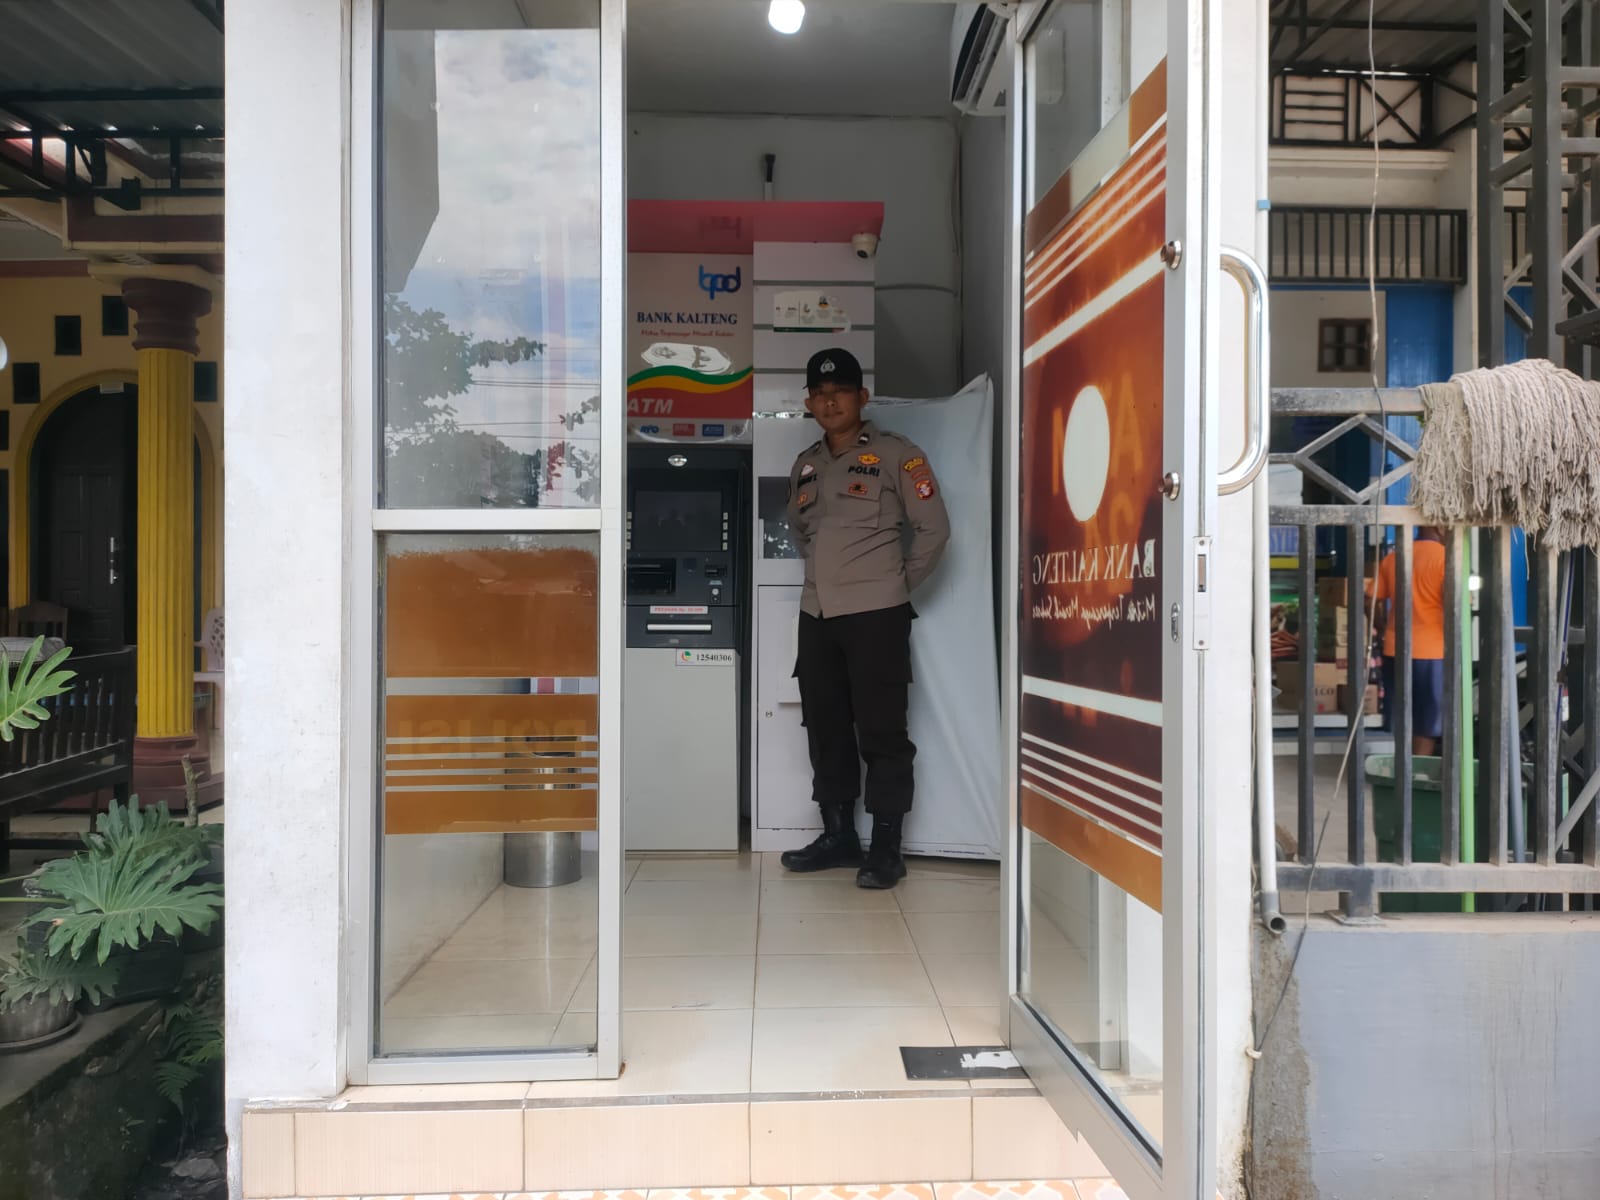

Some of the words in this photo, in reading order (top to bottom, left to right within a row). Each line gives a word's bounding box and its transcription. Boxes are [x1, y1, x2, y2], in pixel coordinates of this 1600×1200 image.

[637, 311, 672, 324] BANK
[677, 312, 738, 325] KALTENG
[627, 398, 673, 414] ATM
[847, 466, 880, 478] POLRI
[696, 653, 732, 662] 12540306
